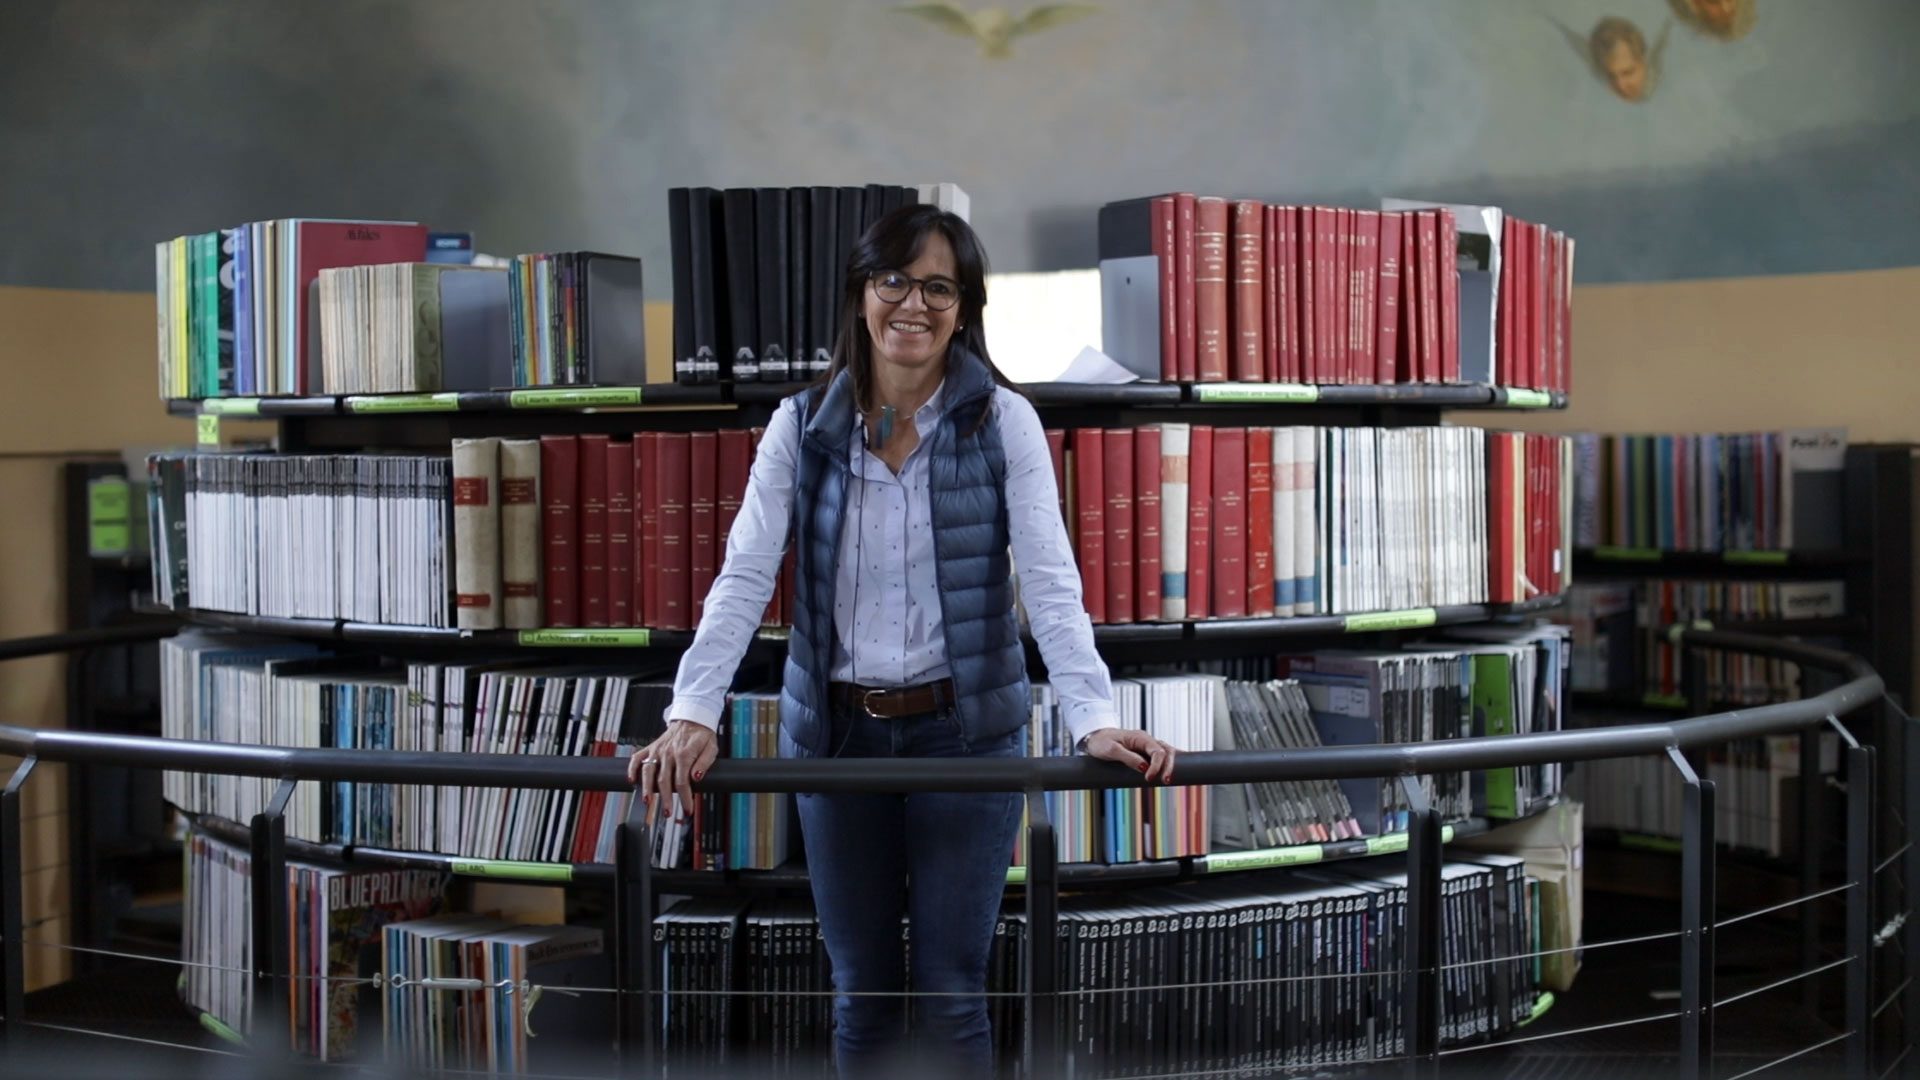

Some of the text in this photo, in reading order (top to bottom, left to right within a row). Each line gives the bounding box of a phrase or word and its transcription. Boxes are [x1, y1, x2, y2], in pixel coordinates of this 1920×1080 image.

[537, 633, 619, 643] Architectural Review
[330, 870, 420, 911] BLUEPRINT
